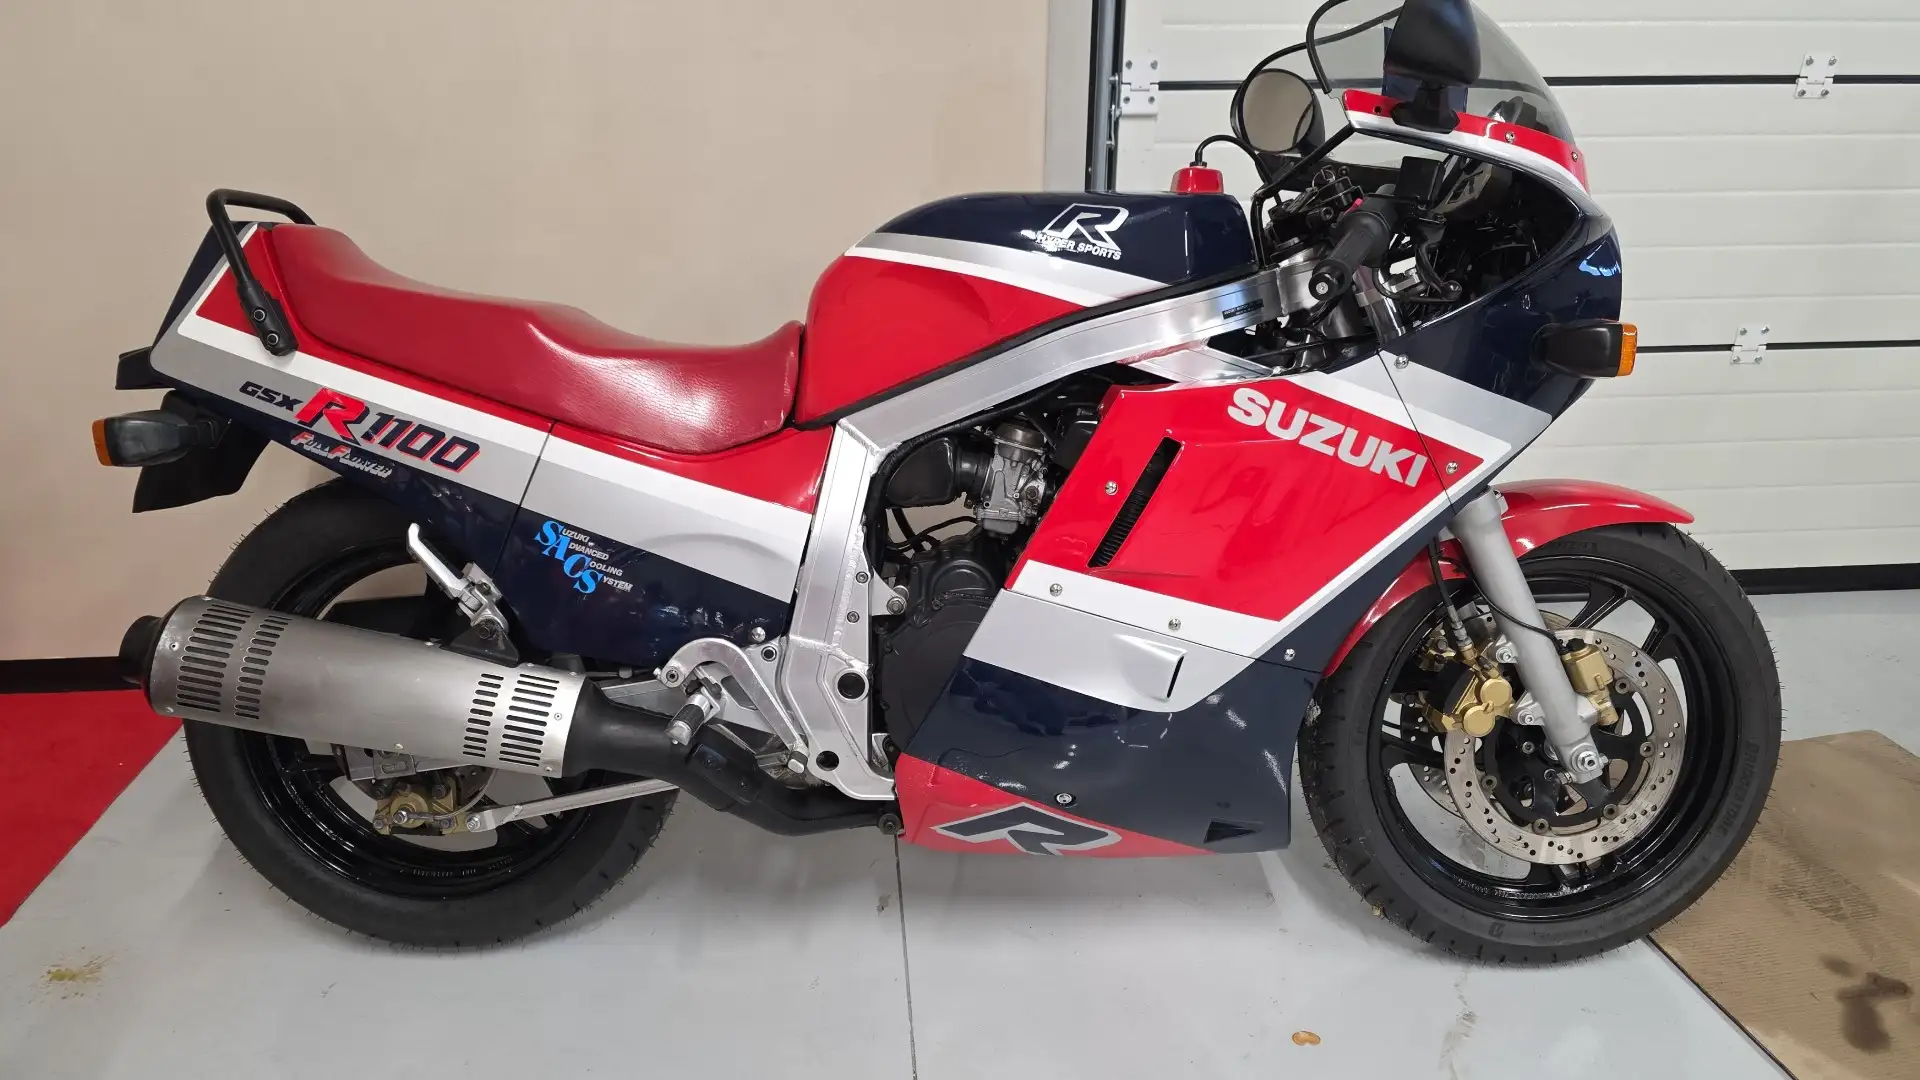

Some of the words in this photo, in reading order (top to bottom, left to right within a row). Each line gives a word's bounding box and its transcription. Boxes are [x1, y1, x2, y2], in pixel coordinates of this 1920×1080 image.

[1041, 203, 1129, 251] R
[1077, 242, 1122, 260] SPORTS
[239, 381, 304, 412] GSX
[1227, 387, 1428, 488] SUZUKI
